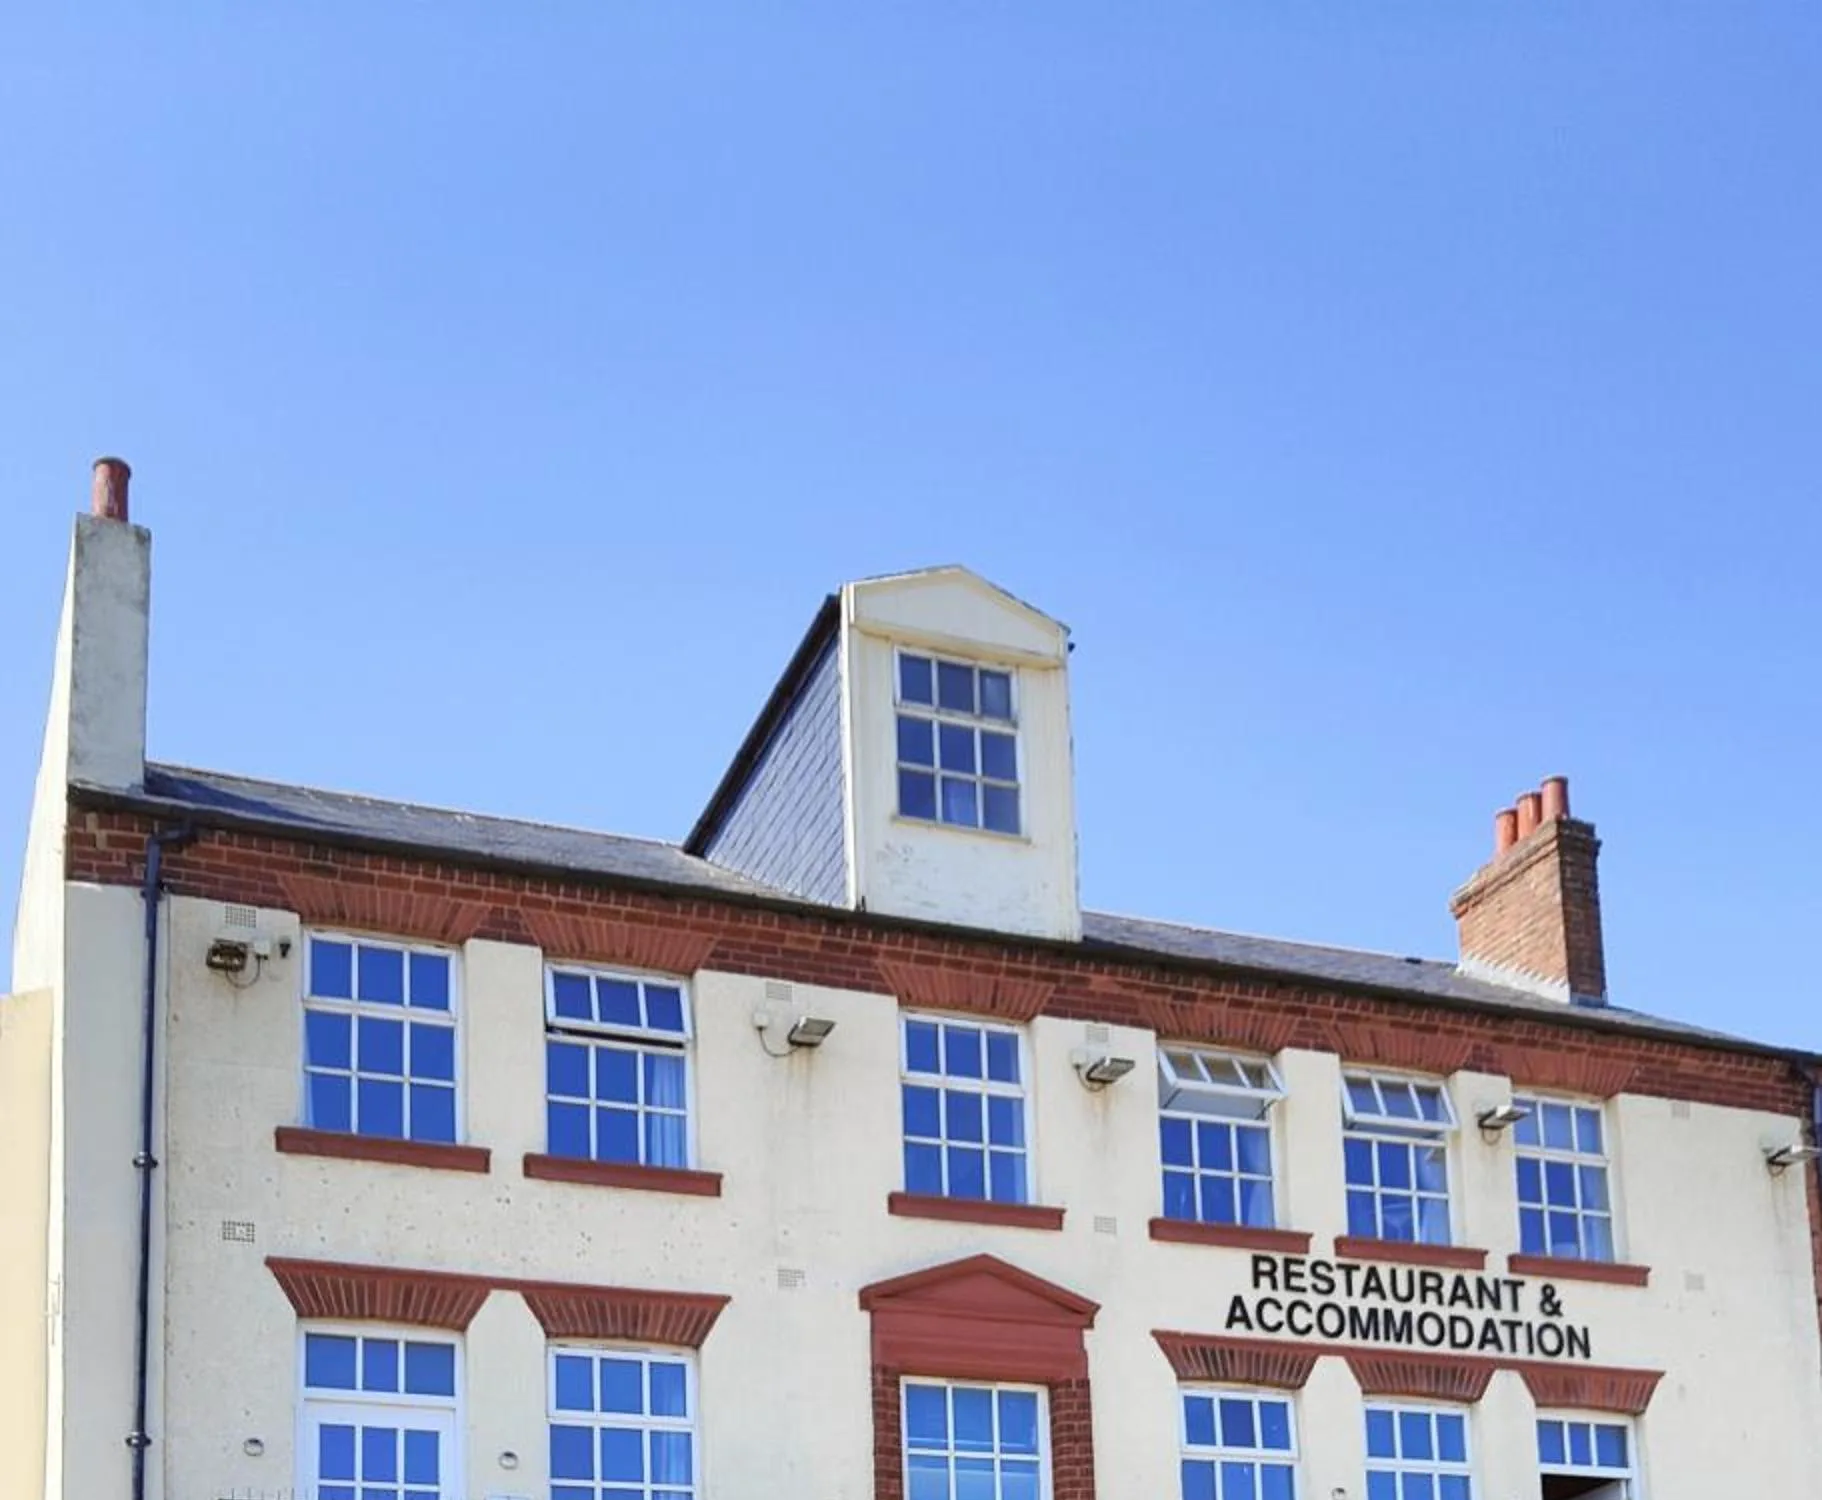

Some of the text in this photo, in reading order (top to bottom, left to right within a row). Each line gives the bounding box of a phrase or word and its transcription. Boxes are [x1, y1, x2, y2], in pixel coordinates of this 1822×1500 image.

[1251, 1254, 1563, 1316] RESTAURANT &
[1225, 1295, 1592, 1359] ACCOMMODATION
